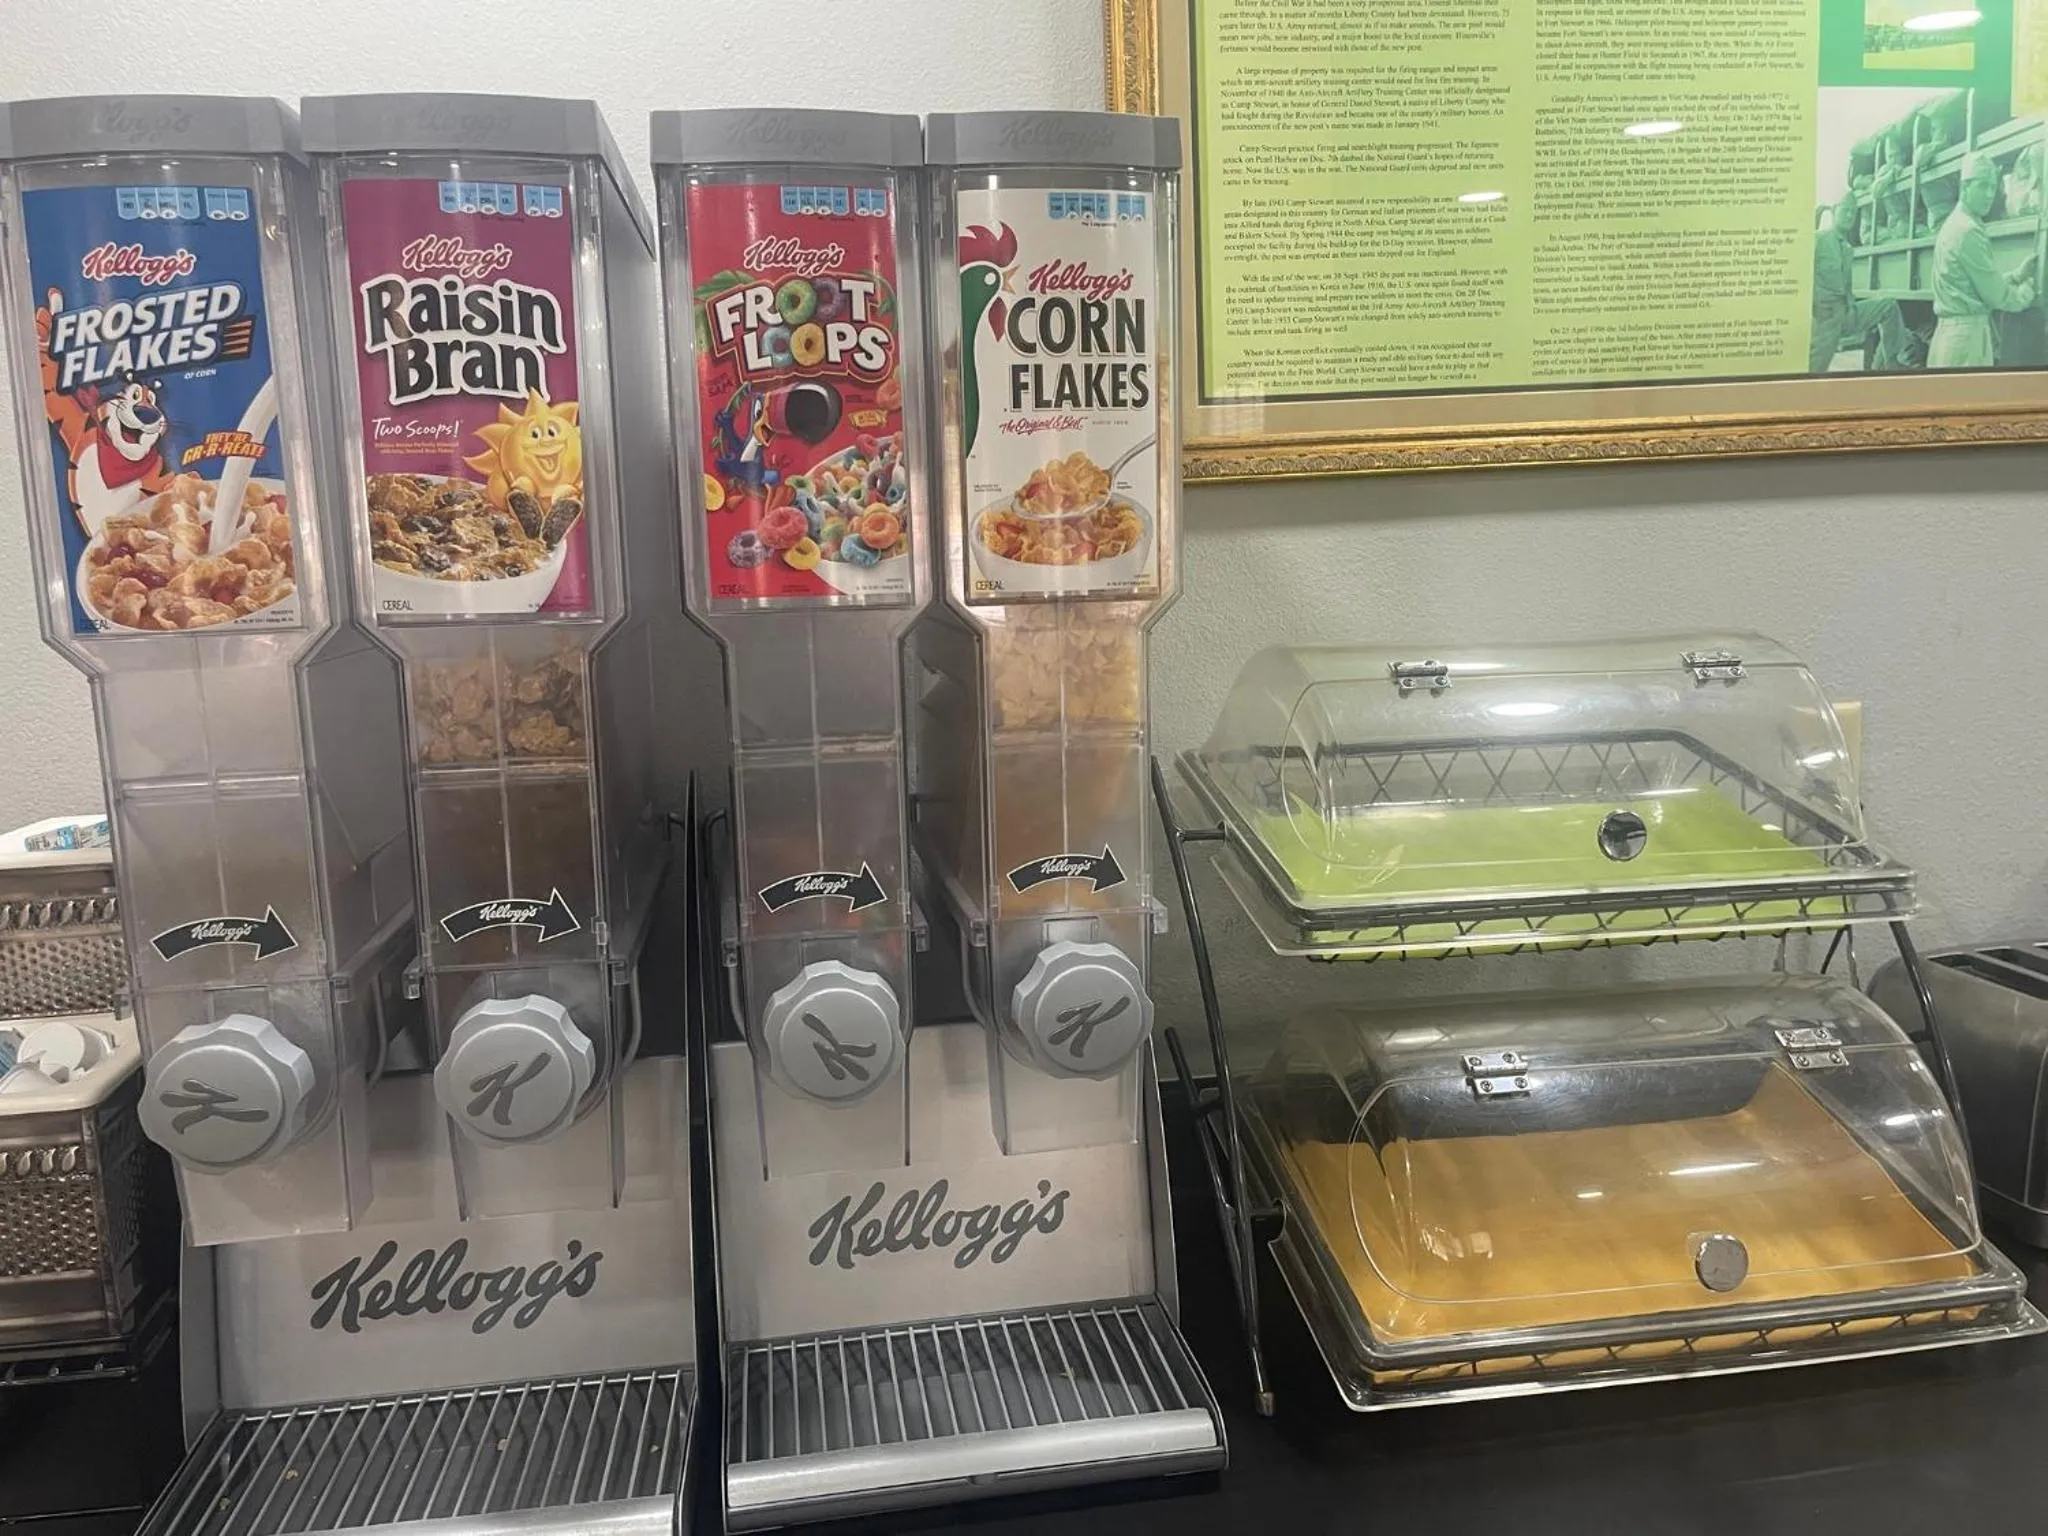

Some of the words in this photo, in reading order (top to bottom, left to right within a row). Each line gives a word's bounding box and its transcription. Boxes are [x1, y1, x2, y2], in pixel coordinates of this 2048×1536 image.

[83, 242, 196, 285] Kellogg's
[403, 235, 512, 278] Kellogg's
[744, 236, 844, 275] Kellogg's
[1028, 258, 1134, 301] Kellogg's
[54, 284, 241, 353] FROSTED
[364, 277, 563, 350] Raisin
[715, 279, 875, 343] FROOT
[1007, 297, 1145, 355] CORN
[62, 323, 218, 389] FLAKES
[743, 323, 890, 371] LOOPS
[196, 369, 217, 379] CORN
[391, 339, 546, 401] Bran
[1010, 363, 1150, 411] FLAKES
[372, 417, 402, 440] Two
[406, 420, 459, 440] Scoops!
[999, 420, 1015, 434] The
[382, 600, 414, 611] CEREAL
[975, 580, 1005, 590] CEREAL
[795, 877, 849, 894] Kellogg's
[1041, 859, 1091, 875] Kellogg's
[191, 922, 253, 940] Kellogg's
[479, 904, 538, 922] Kellogg's
[1048, 997, 1130, 1058] K
[466, 1052, 551, 1126] K
[808, 1179, 1071, 1270] Kellogg's
[310, 1237, 603, 1334] Kellogg's
